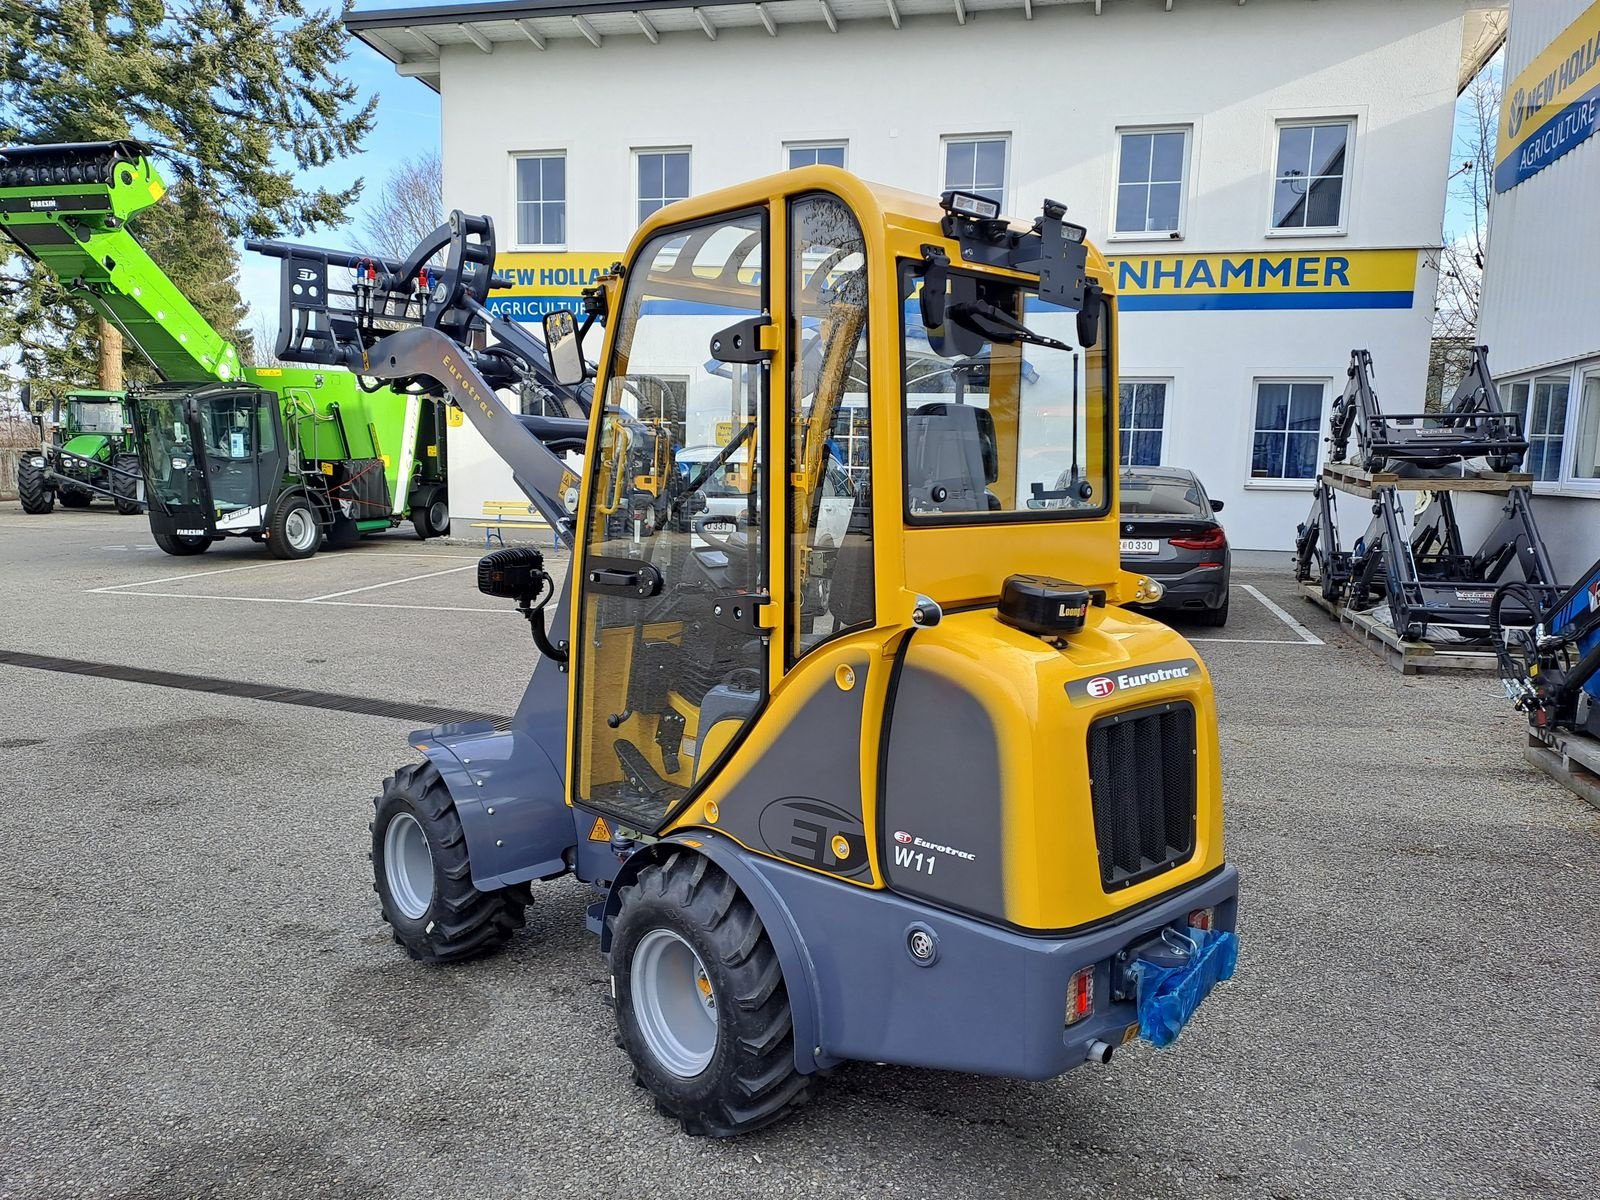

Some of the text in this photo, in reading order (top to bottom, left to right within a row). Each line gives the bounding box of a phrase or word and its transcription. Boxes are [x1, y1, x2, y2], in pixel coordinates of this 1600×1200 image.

[1525, 69, 1557, 121] NEW
[1520, 97, 1596, 172] AGRICULTURE
[1108, 256, 1350, 289] NHAMMER
[442, 355, 494, 419] Eurotrac
[1089, 666, 1190, 696] ET Eurotrac
[895, 845, 936, 875] W11
[913, 837, 976, 861] Eurotrac
